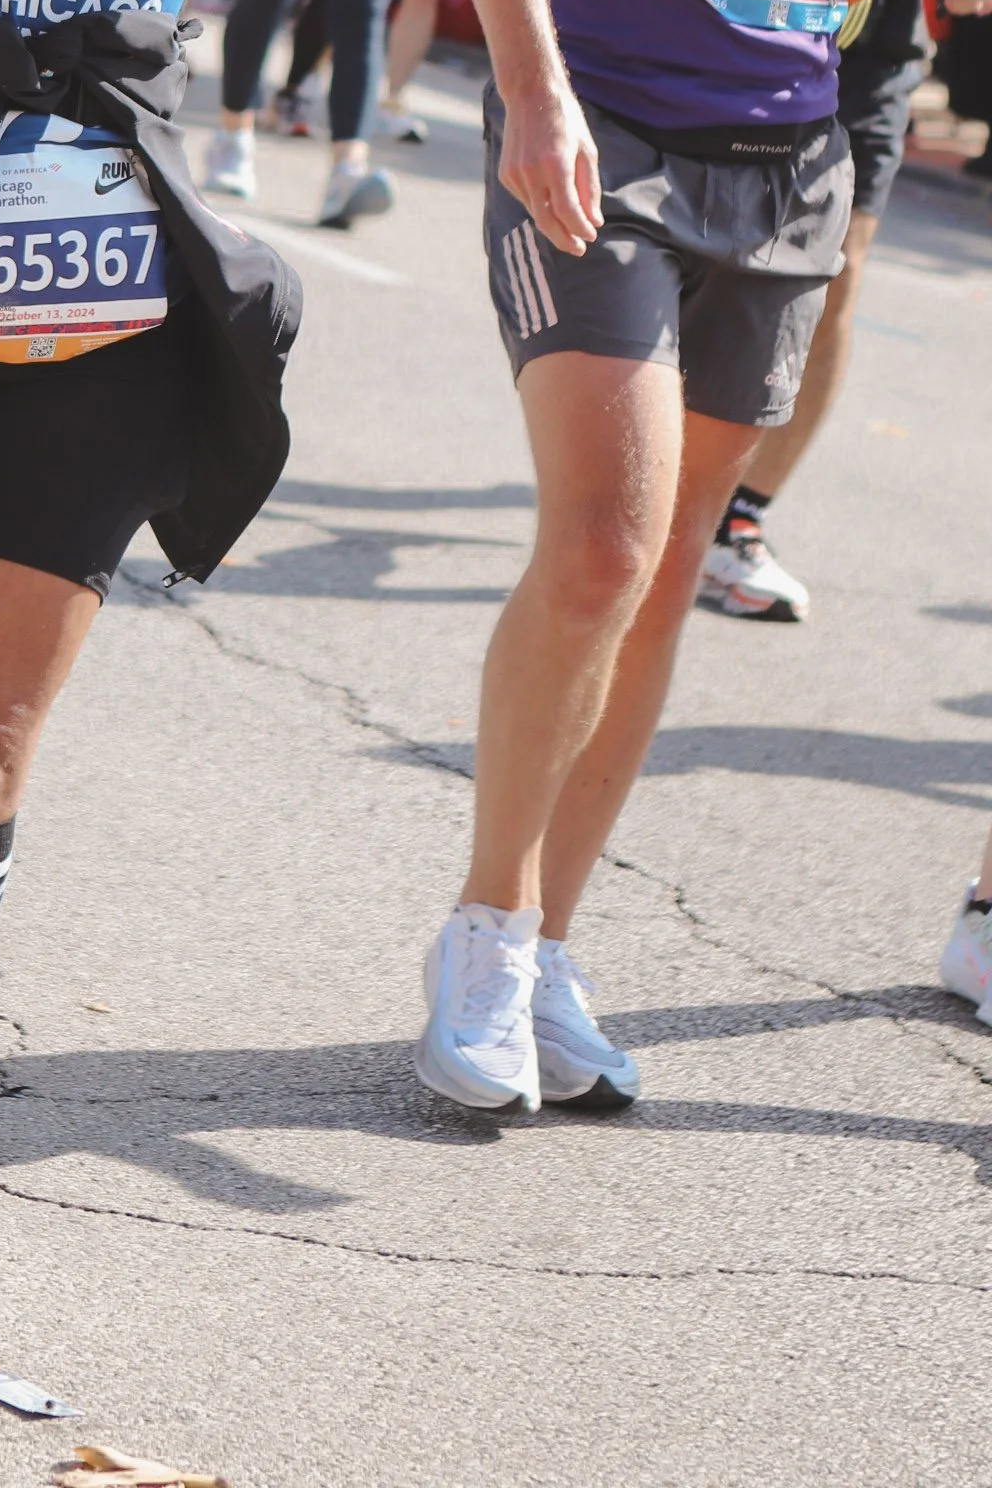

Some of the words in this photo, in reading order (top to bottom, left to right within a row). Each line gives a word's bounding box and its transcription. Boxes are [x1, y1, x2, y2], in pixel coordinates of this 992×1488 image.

[742, 144, 792, 153] NATHAN
[13, 167, 48, 175] AMERICA
[101, 162, 132, 180] RUN
[46, 309, 64, 320] 13,
[67, 307, 96, 318] 2024
